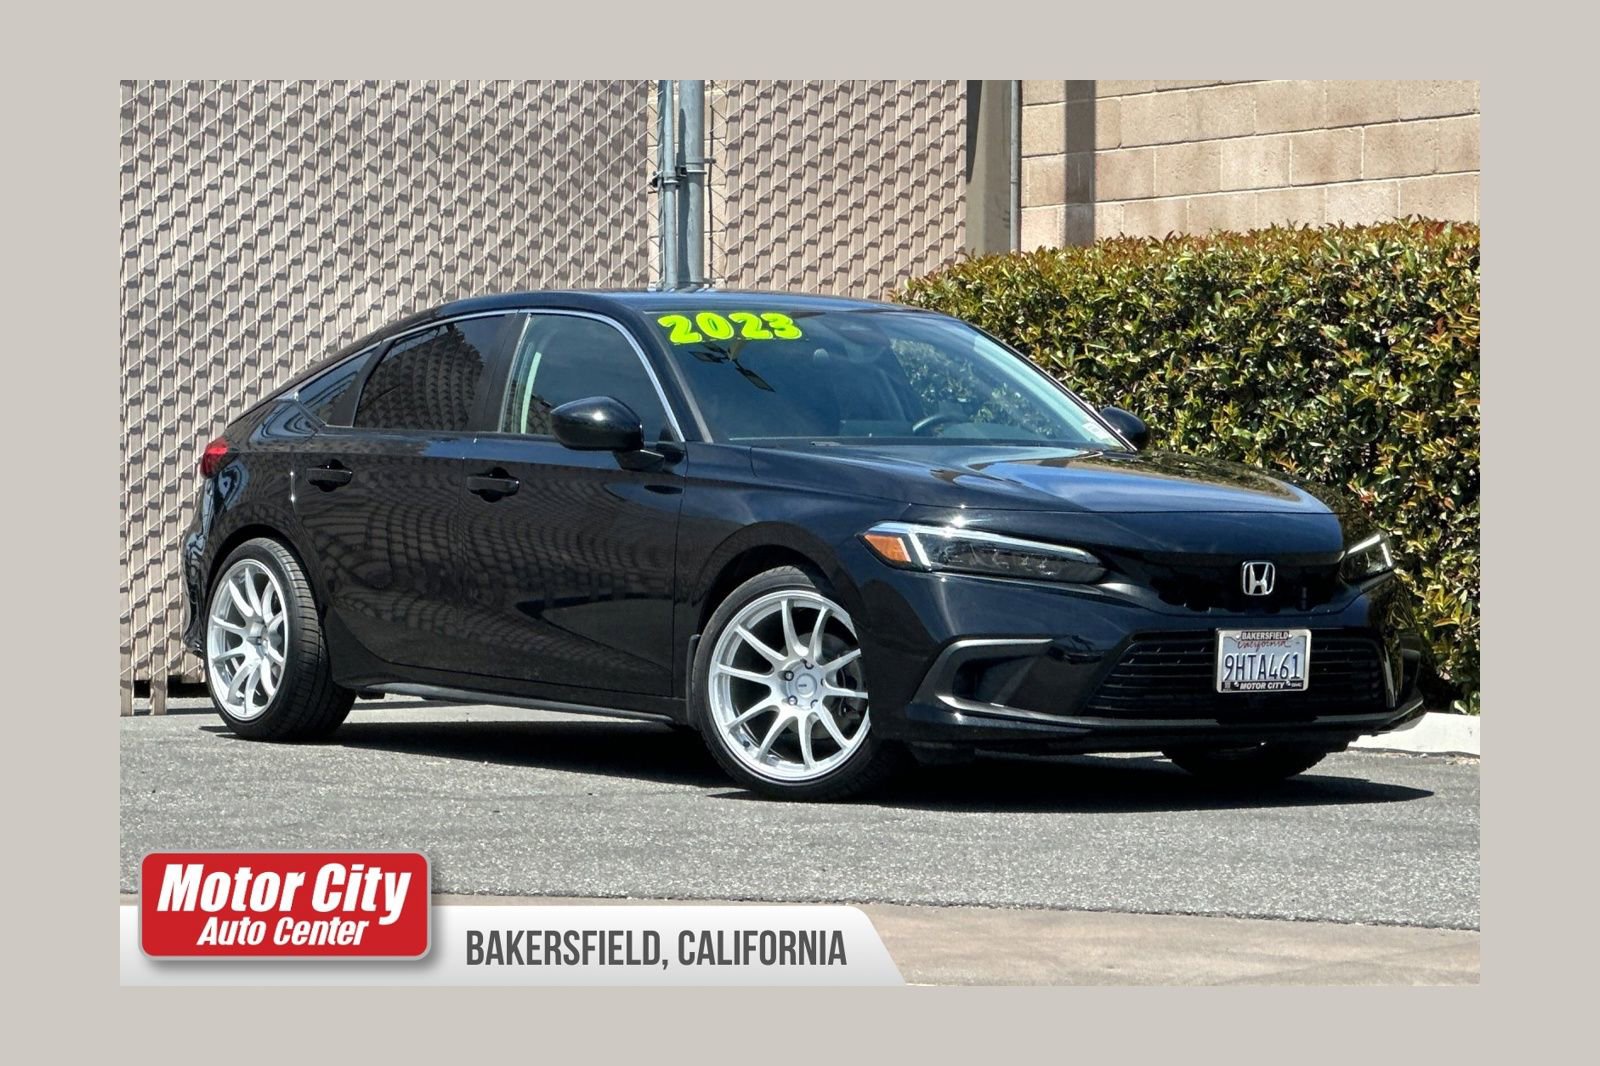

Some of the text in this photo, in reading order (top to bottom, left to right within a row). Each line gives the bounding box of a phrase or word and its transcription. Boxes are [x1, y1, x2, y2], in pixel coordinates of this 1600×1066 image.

[657, 312, 803, 344] 2023
[1241, 631, 1289, 641] BAKERSFIELD
[1223, 653, 1301, 681] 9HTA461
[1239, 682, 1266, 690] MOTOR
[1267, 681, 1285, 689] CITY
